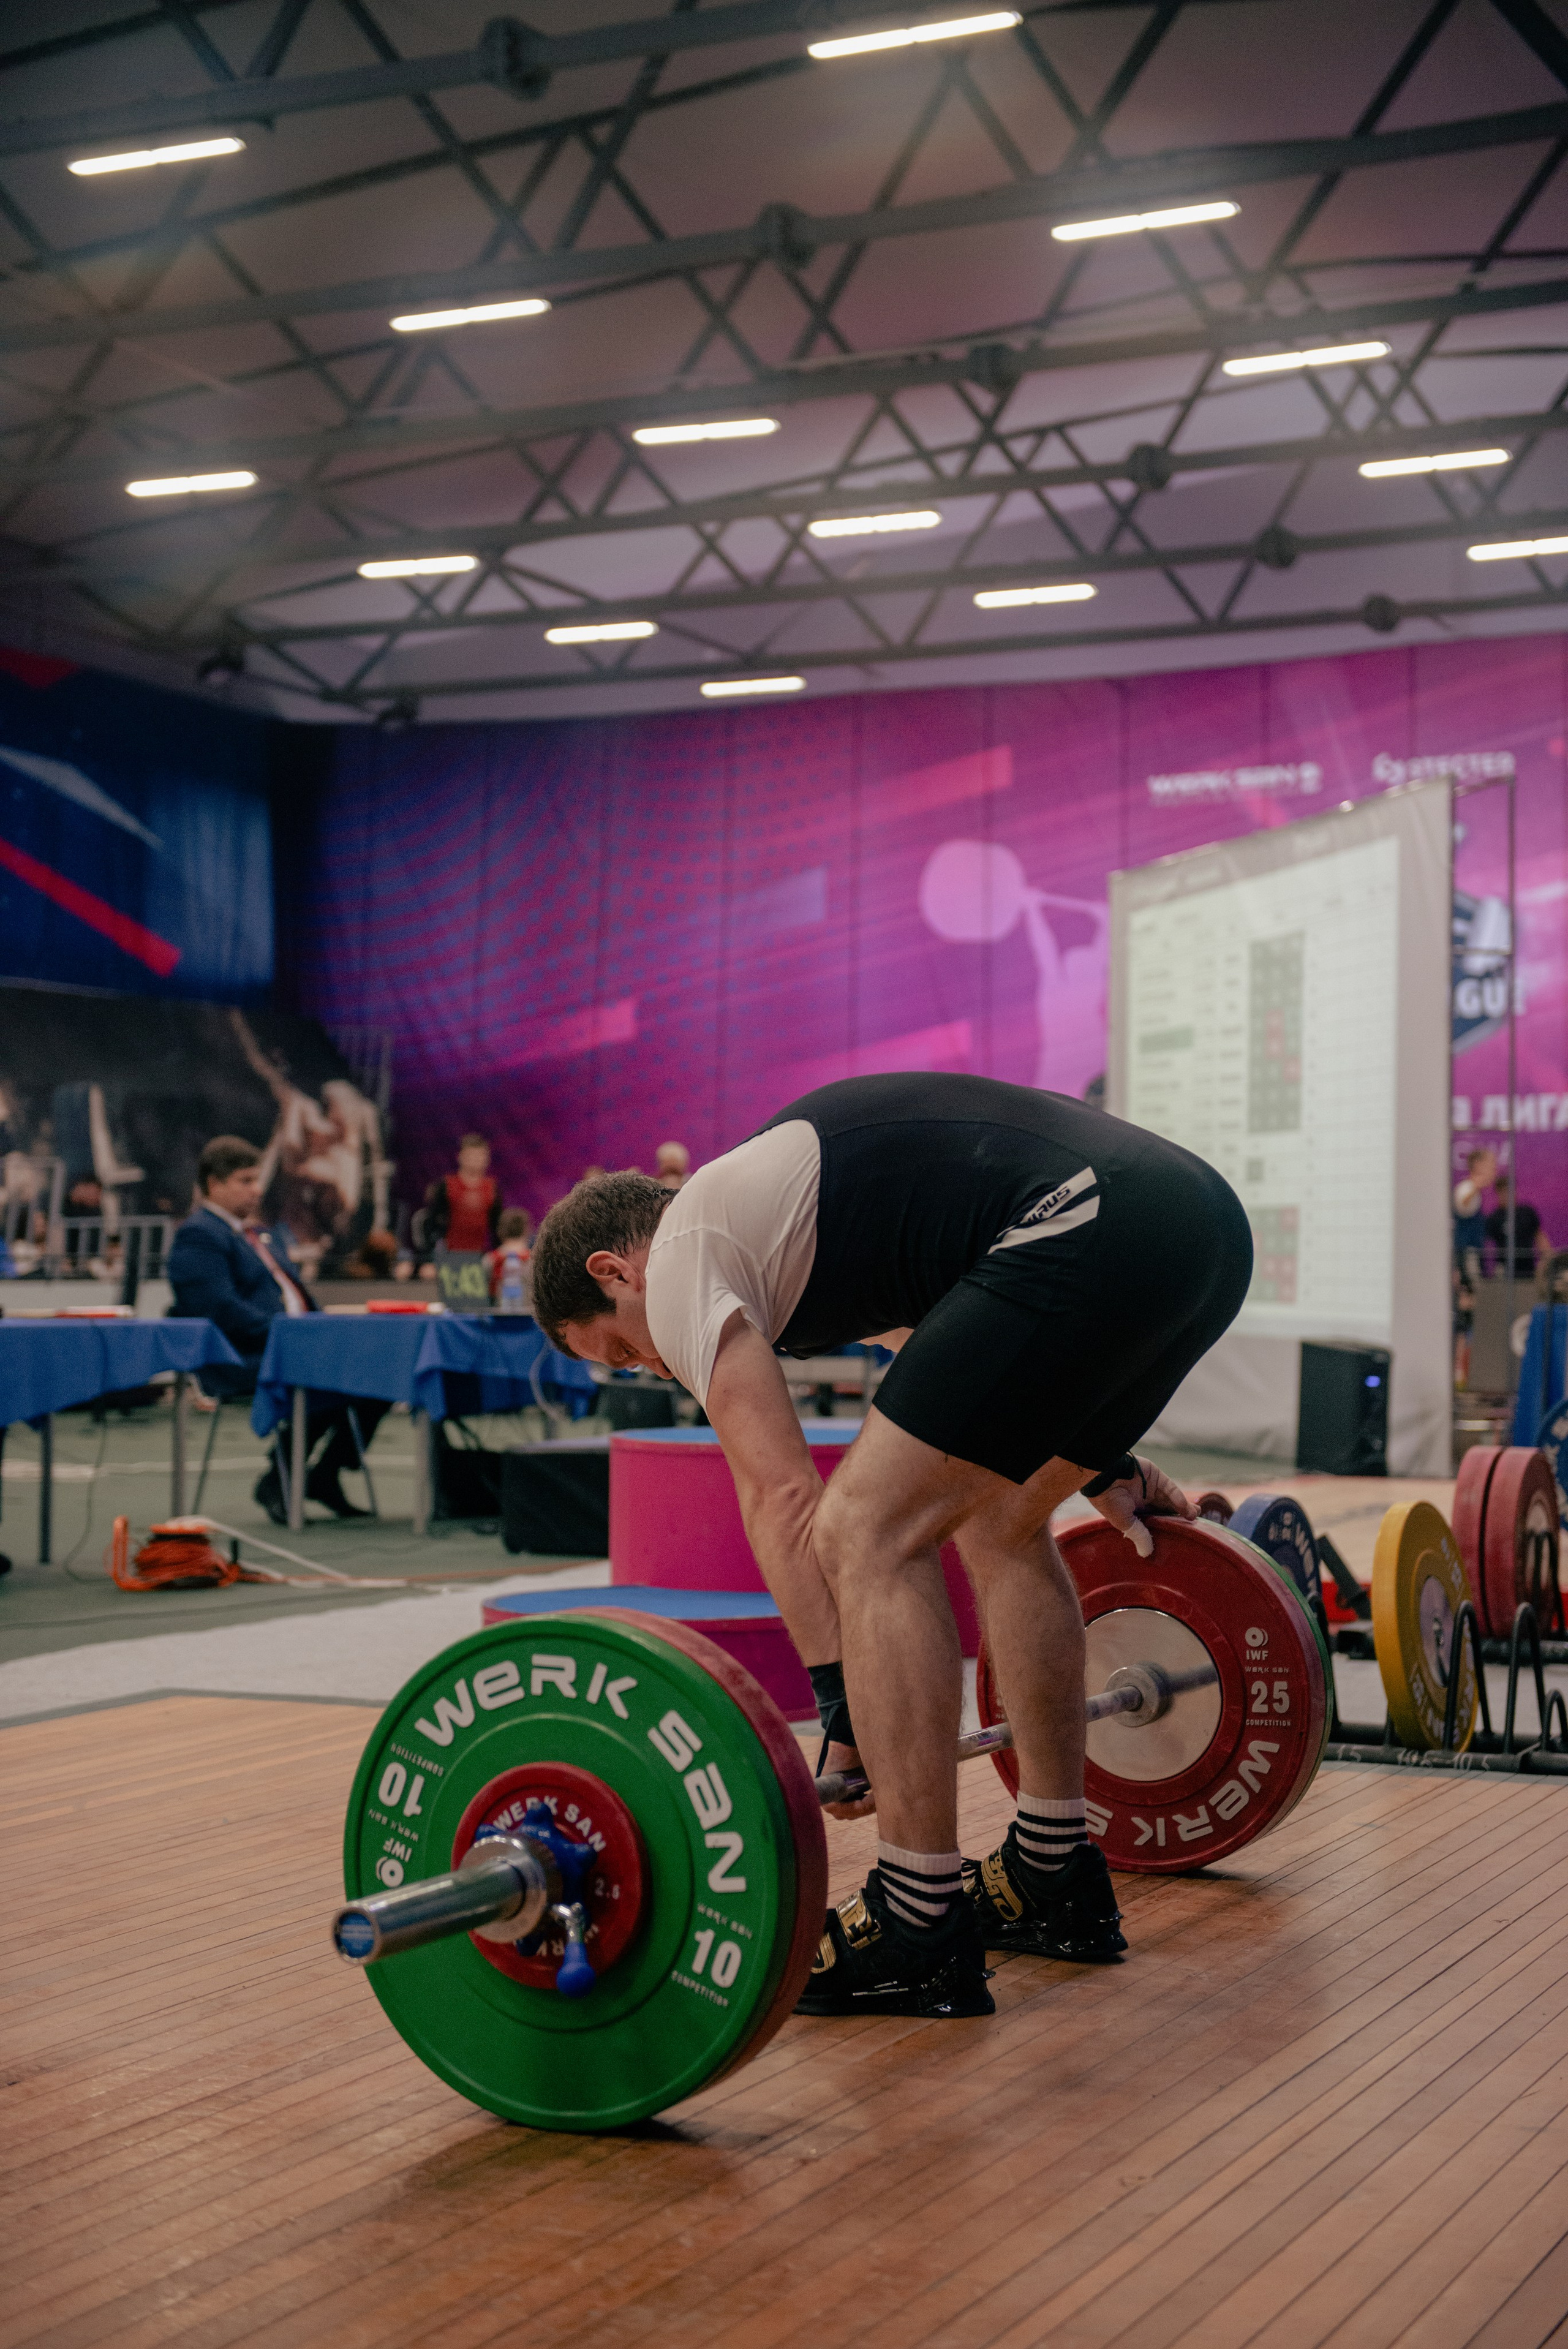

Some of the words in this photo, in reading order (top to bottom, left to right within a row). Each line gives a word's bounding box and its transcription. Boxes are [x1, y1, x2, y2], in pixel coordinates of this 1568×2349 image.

[1245, 1650, 1268, 1661] IWF
[1251, 1680, 1290, 1713] 25
[390, 1743, 444, 1777] COMPETITION
[415, 1653, 638, 1747] WERK
[647, 1710, 747, 1893] SAN
[379, 1762, 424, 1817] 10
[1131, 1740, 1280, 1847] WERK
[383, 1838, 412, 1863] IWF
[564, 1803, 606, 1852] SAN
[692, 1929, 742, 1988] 10
